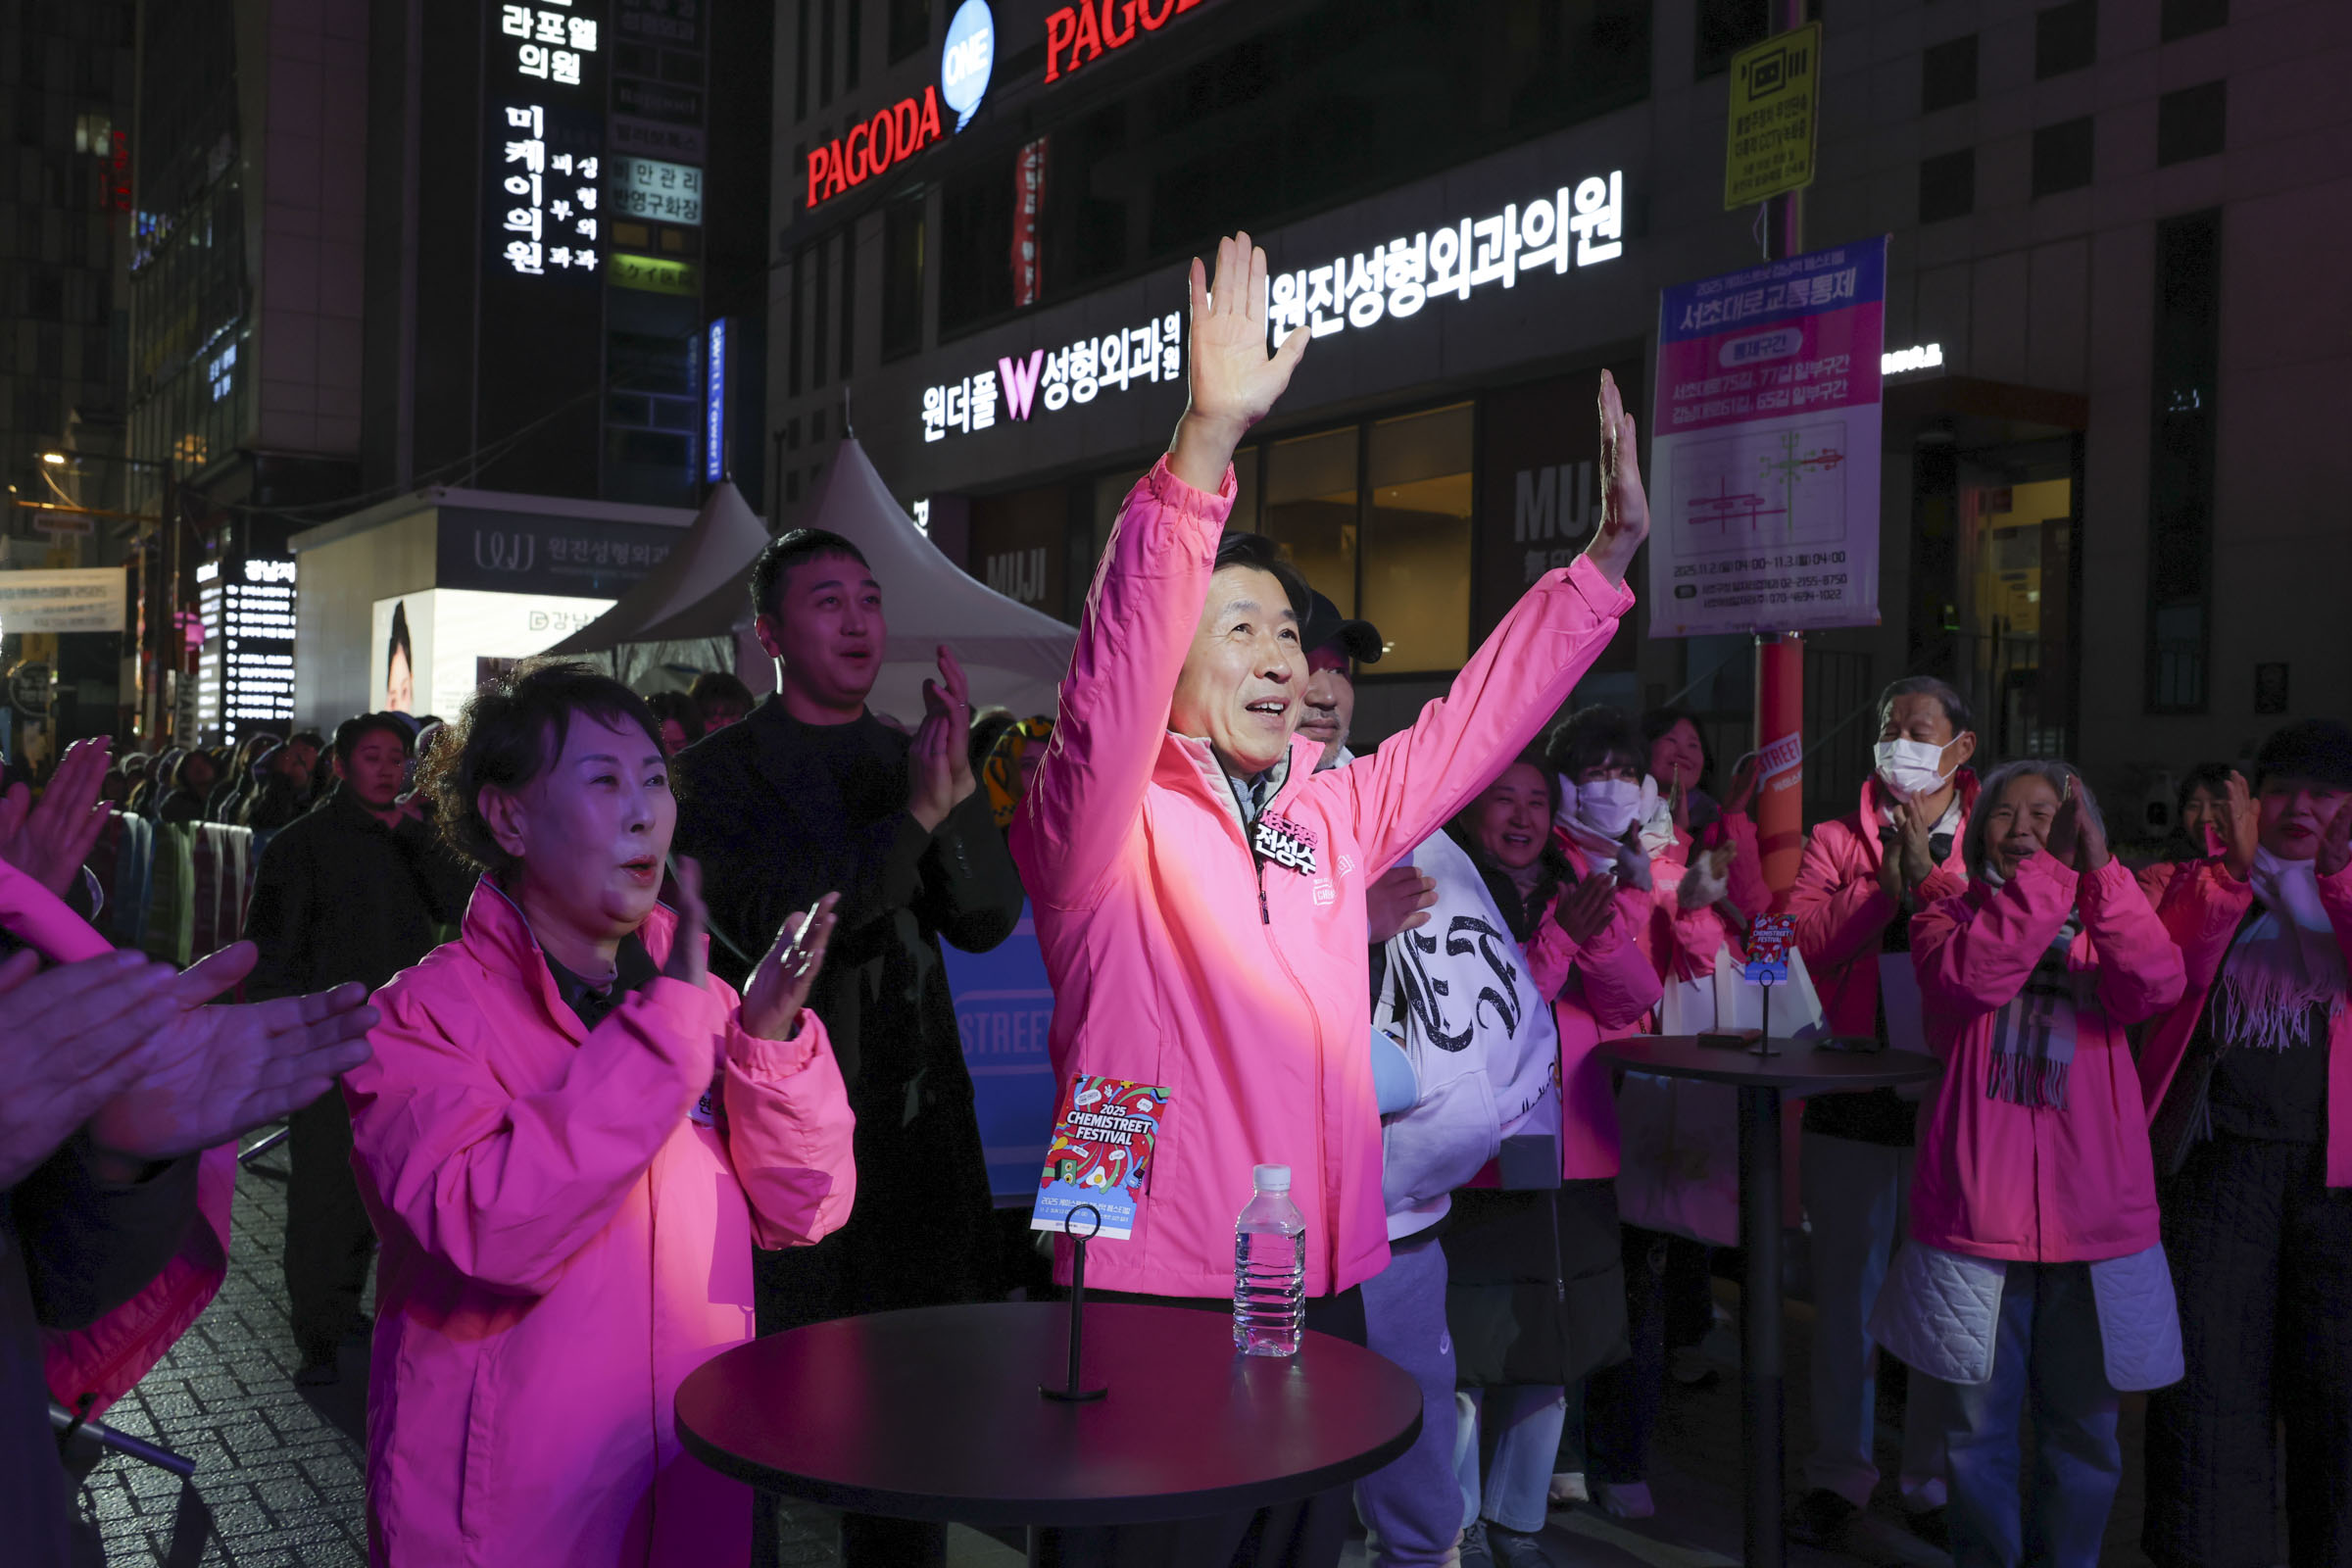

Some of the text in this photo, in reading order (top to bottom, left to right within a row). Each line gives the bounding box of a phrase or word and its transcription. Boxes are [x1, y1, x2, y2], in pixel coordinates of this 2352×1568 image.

[518, 44, 580, 85] 의원
[945, 27, 989, 87] ONE
[1044, 0, 1201, 84] PAG
[807, 84, 943, 209] PAGODA
[503, 104, 546, 274] 미케이의원
[548, 153, 574, 269] 피부과
[574, 156, 599, 271] 성형외과
[1268, 170, 1623, 349] 원진성형외과의원
[921, 370, 999, 442] 원더풀
[998, 349, 1045, 421] W
[1040, 318, 1163, 412] 성형외과
[987, 547, 1047, 603] MUJI
[1812, 551, 1846, 566] 04:00
[1255, 823, 1317, 875] 전성수
[1259, 808, 1318, 851] 서초구청장
[1066, 1110, 1152, 1135] CHEMISTREET
[1075, 1126, 1133, 1146] FESTIVAL
[1100, 1103, 1127, 1116] 2025
